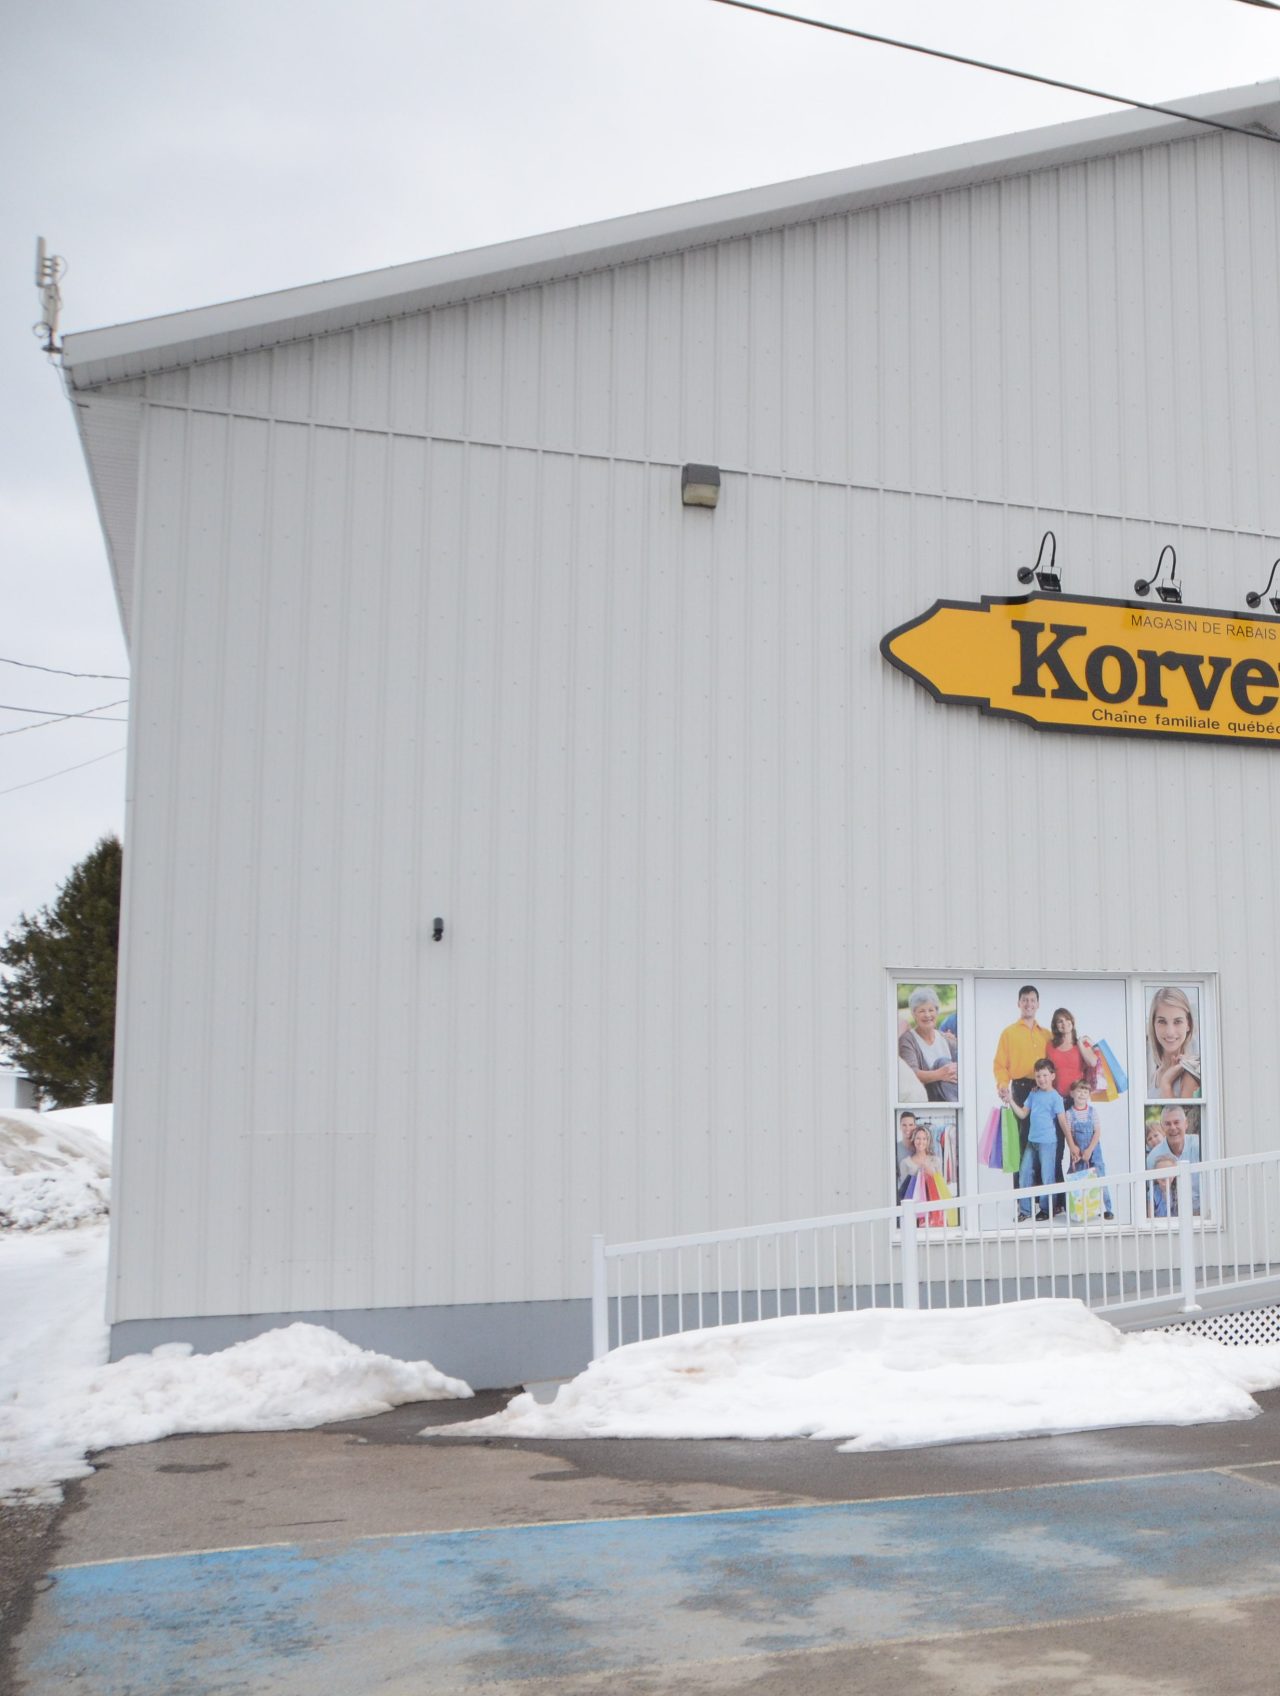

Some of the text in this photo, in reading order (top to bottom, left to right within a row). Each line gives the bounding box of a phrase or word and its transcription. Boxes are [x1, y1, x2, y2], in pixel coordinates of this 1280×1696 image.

[1131, 615, 1278, 640] MAGASIN DE RABAIS
[1092, 708, 1148, 725] Chaîne
[1155, 713, 1221, 730] familiale
